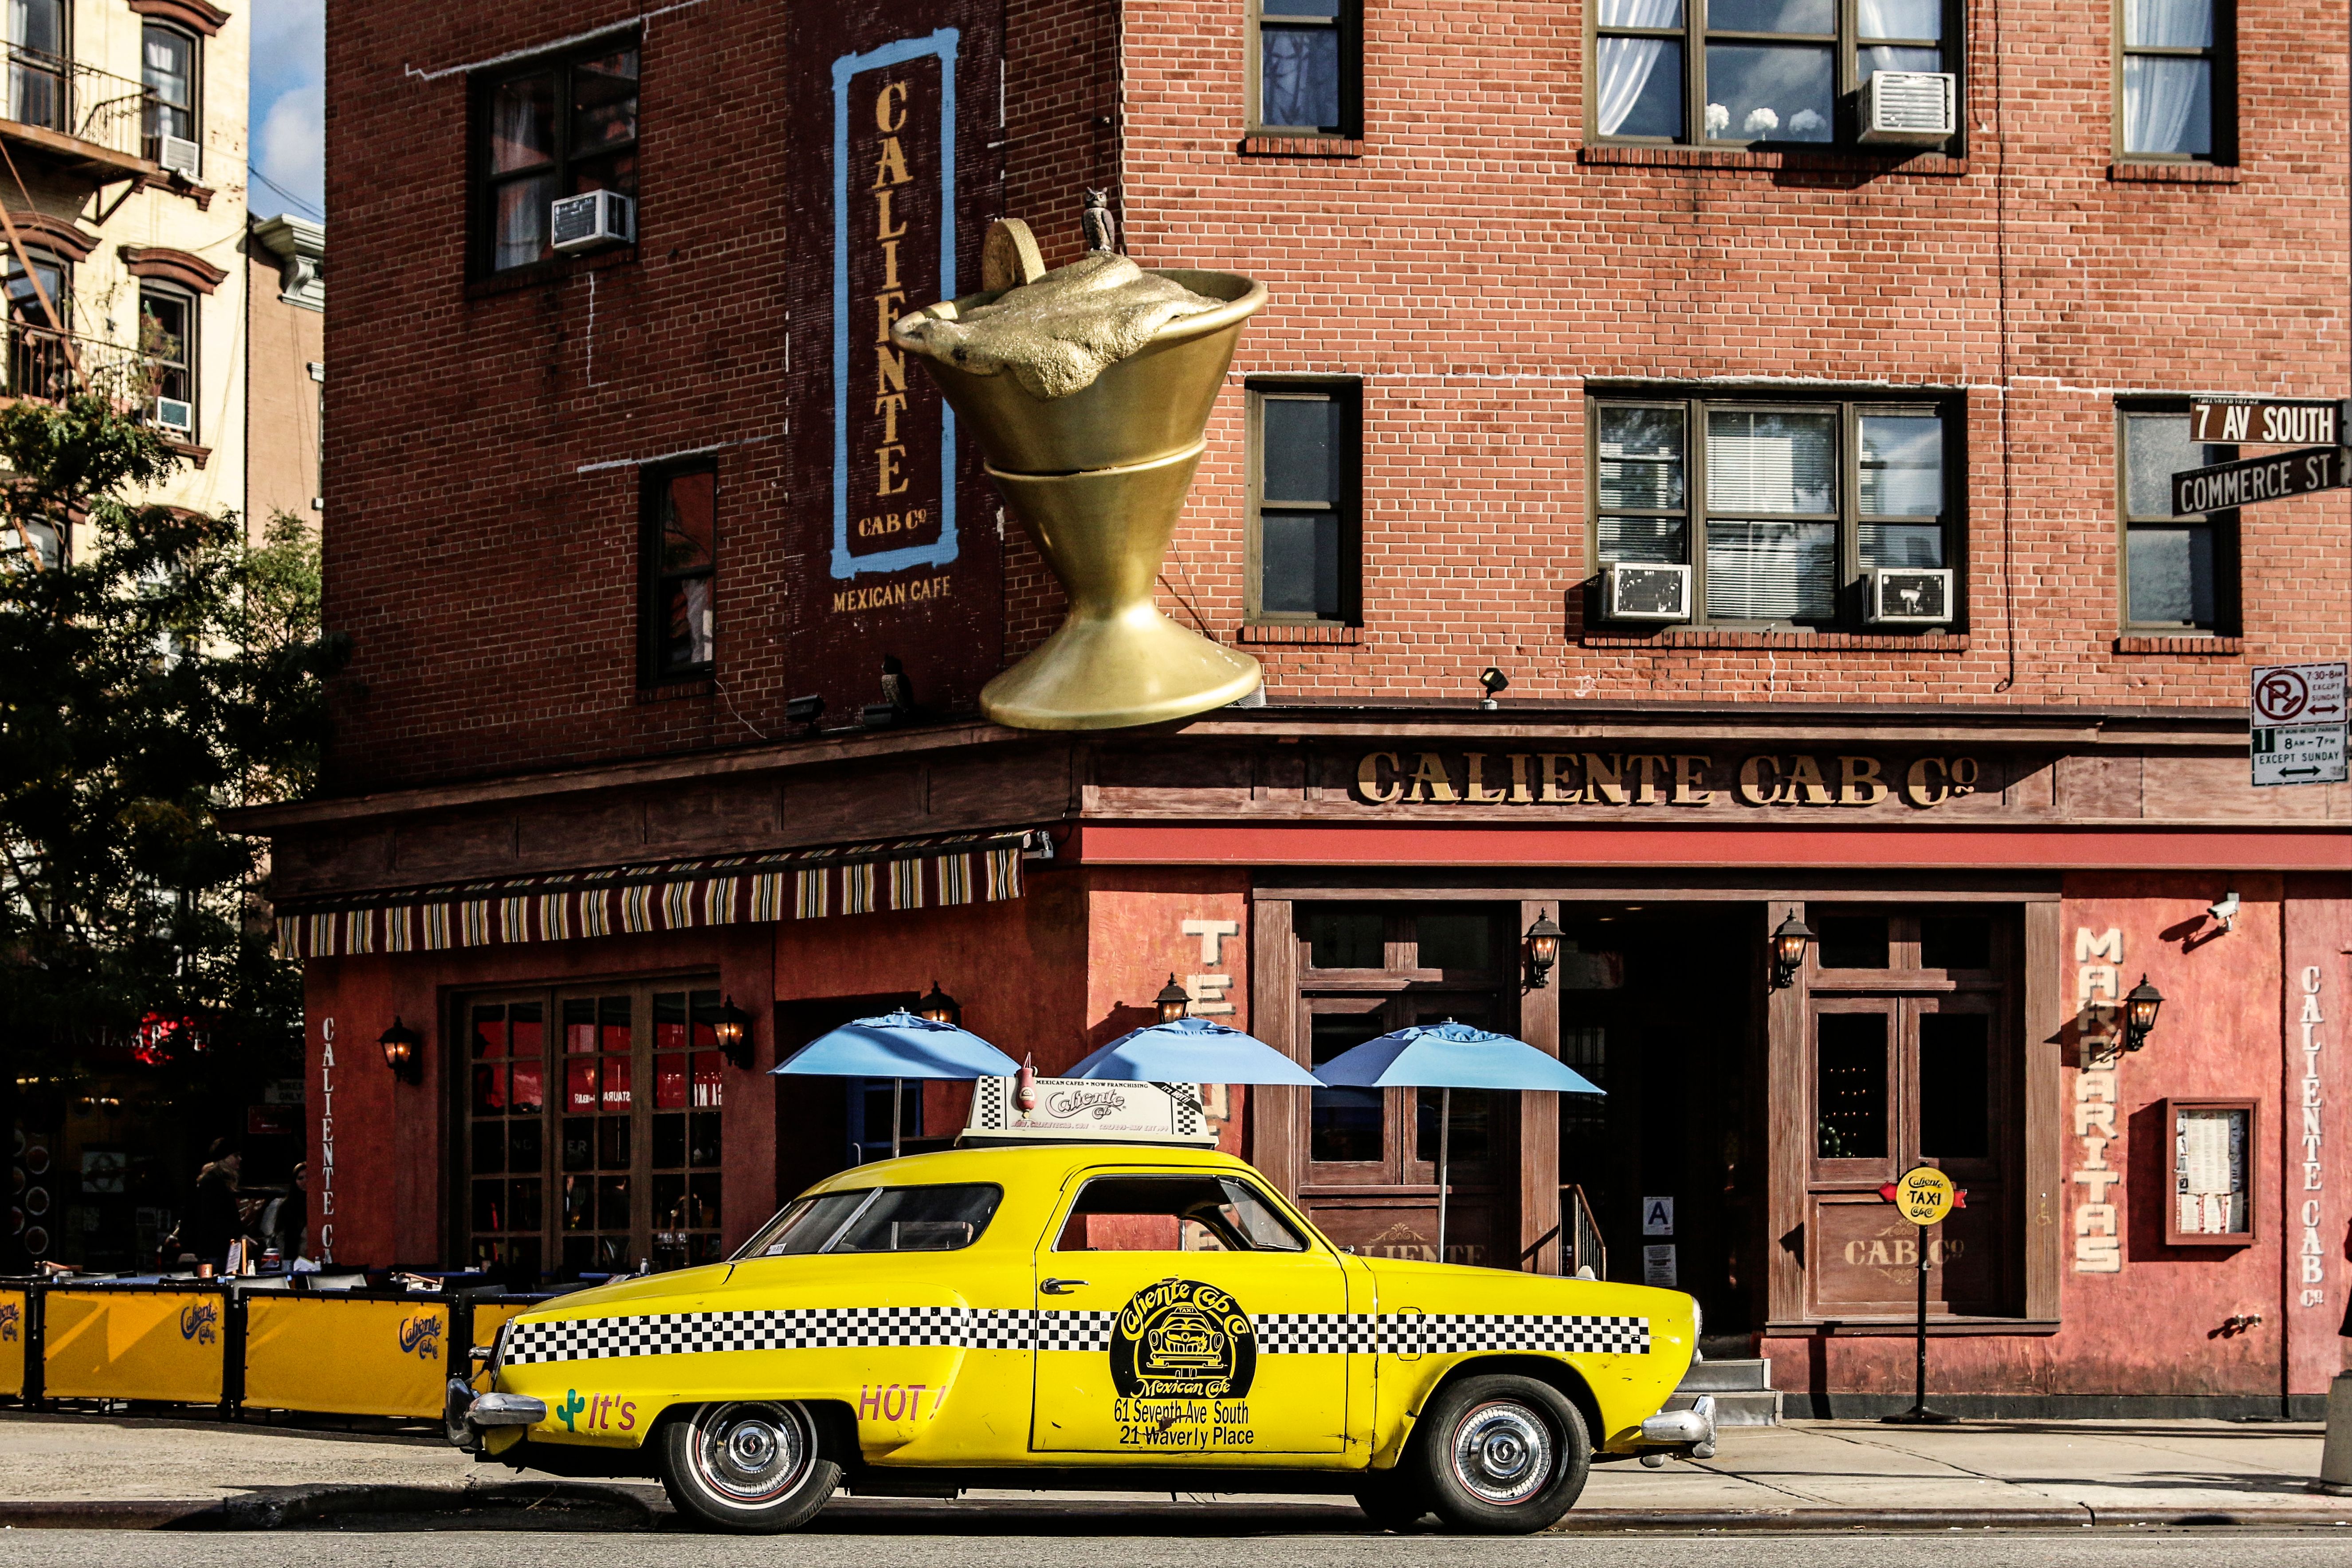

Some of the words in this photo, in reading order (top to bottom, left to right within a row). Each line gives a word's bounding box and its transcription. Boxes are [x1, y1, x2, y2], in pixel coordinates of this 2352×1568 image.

[872, 81, 914, 497] CALIENTE
[2195, 405, 2210, 440] 7
[2222, 405, 2250, 440] AV
[2262, 406, 2334, 443] SOUTH
[2180, 461, 2292, 513] COMMERCE
[2306, 454, 2331, 490] ST
[858, 513, 901, 537] CAB
[834, 583, 906, 613] MEXICAN
[911, 575, 951, 601] CAFE
[2259, 754, 2295, 764] EXCEPT
[2302, 751, 2340, 762] SUNDAY
[2260, 729, 2266, 751] 1
[1357, 751, 1713, 805] CALIENTE
[1739, 755, 1888, 805] CAB
[2300, 966, 2324, 1191] CALIENTE
[322, 1018, 335, 1215] CALIENTE
[1045, 1089, 1125, 1118] Caliente
[1092, 1106, 1112, 1120] Cab
[2074, 927, 2123, 1273] MARGARITAS
[1908, 1175, 1943, 1188] Caliente
[1910, 1191, 1941, 1206] TAXI
[1648, 1202, 1669, 1225] A
[1845, 1240, 1919, 1265] CAB
[2301, 1199, 2324, 1285] CAB
[181, 1301, 217, 1340] Caliente
[1121, 1281, 1190, 1341] Caliente
[1193, 1286, 1233, 1313] Cab
[399, 1314, 441, 1353] Caliente
[1131, 1378, 1203, 1398] Mexican
[1205, 1377, 1232, 1398] Cafe
[588, 1392, 637, 1430] It's
[858, 1384, 927, 1422] HOT
[1114, 1398, 1130, 1422] 61
[1134, 1399, 1181, 1423] Seventh
[1186, 1400, 1207, 1424] Ave
[1213, 1400, 1249, 1424] South
[1119, 1425, 1140, 1445] 21
[1146, 1426, 1208, 1450] Waverly
[1213, 1427, 1254, 1445] Place
